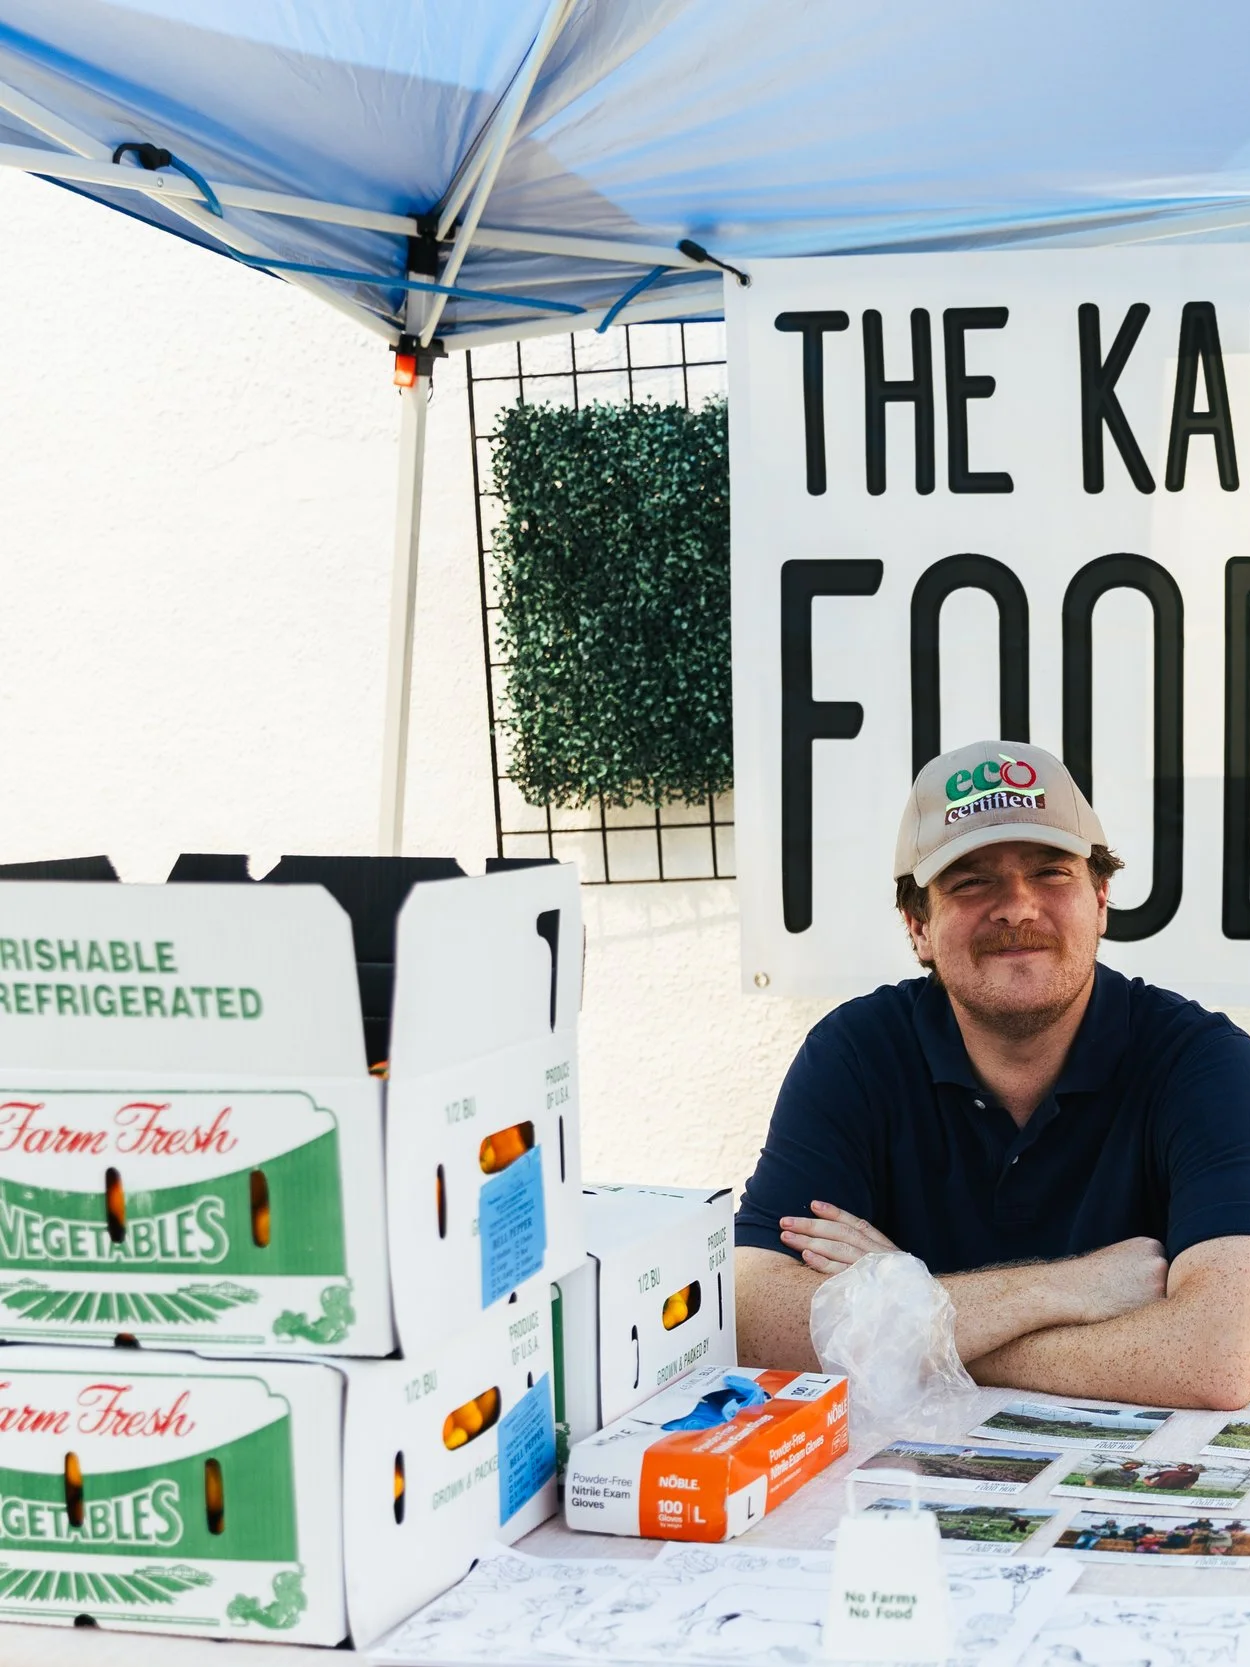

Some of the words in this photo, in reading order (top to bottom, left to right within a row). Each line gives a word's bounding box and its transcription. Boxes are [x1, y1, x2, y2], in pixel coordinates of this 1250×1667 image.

[775, 307, 1014, 495] THE
[946, 761, 1036, 802] eco
[948, 792, 1037, 824] certified
[0, 1101, 108, 1154] Farm
[114, 1102, 239, 1155] Fresh
[638, 1272, 649, 1294] 1/2
[650, 1266, 661, 1288] BU
[0, 1380, 71, 1435] arm
[77, 1383, 196, 1437] Fresh
[769, 1431, 806, 1464] Powder-Free
[474, 1455, 499, 1482] PACKE
[573, 1472, 633, 1487] Powder-Free
[571, 1497, 605, 1509] Gloves
[572, 1485, 600, 1497] Nitrile
[603, 1488, 631, 1499] Exam
[658, 1500, 683, 1514] 100
[694, 1506, 706, 1523] L
[747, 1496, 756, 1520] L
[845, 1591, 866, 1604] No
[871, 1591, 917, 1605] Farms
[849, 1606, 870, 1619] No
[876, 1606, 913, 1620] Food
